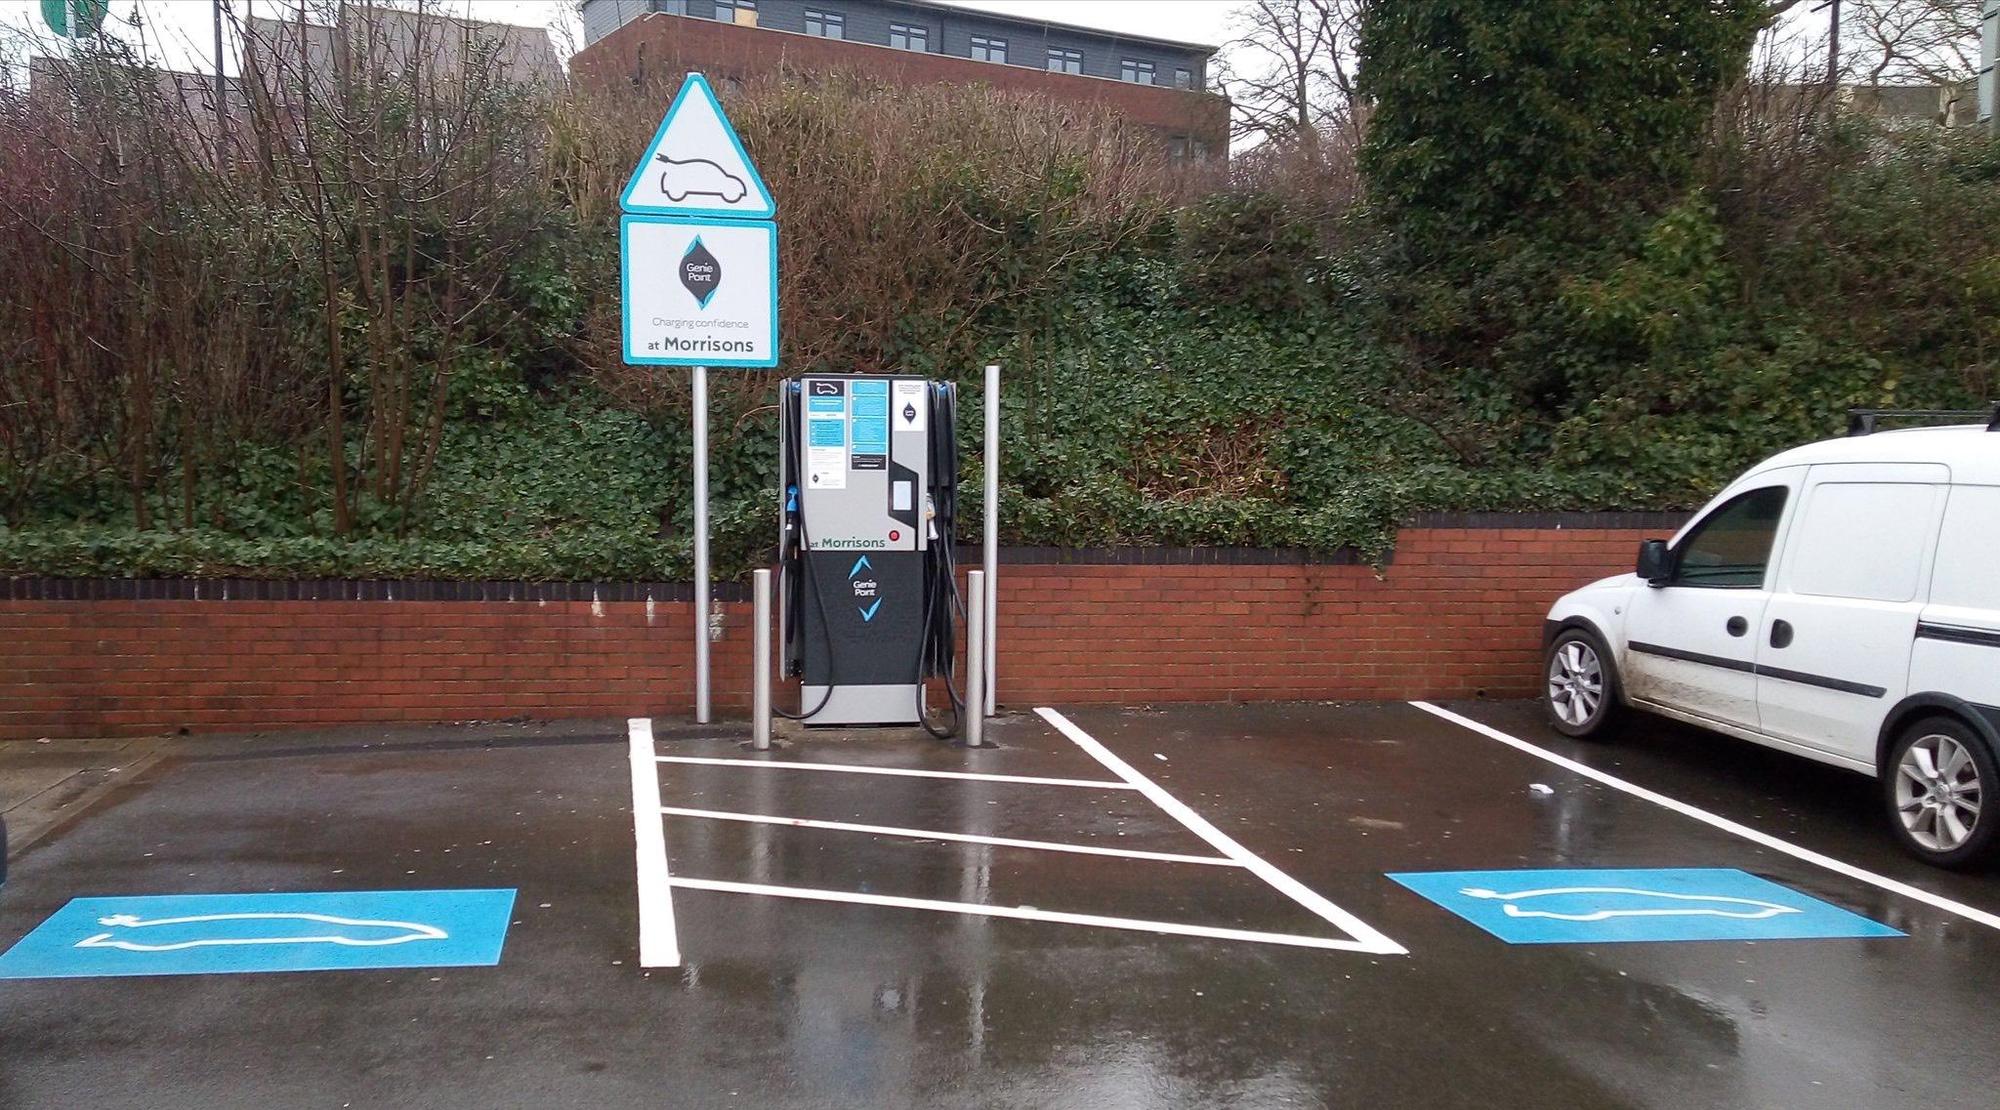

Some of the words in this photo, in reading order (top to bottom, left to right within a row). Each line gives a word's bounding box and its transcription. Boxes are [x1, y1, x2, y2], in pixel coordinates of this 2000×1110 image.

[686, 262, 714, 273] Genie
[688, 272, 712, 282] Point
[652, 317, 694, 329] Charging
[695, 318, 750, 329] confidence
[647, 341, 660, 350] at
[664, 335, 754, 352] Morrisons
[821, 536, 886, 548] Morrisons
[852, 579, 877, 589] Genie
[854, 588, 876, 597] Point
